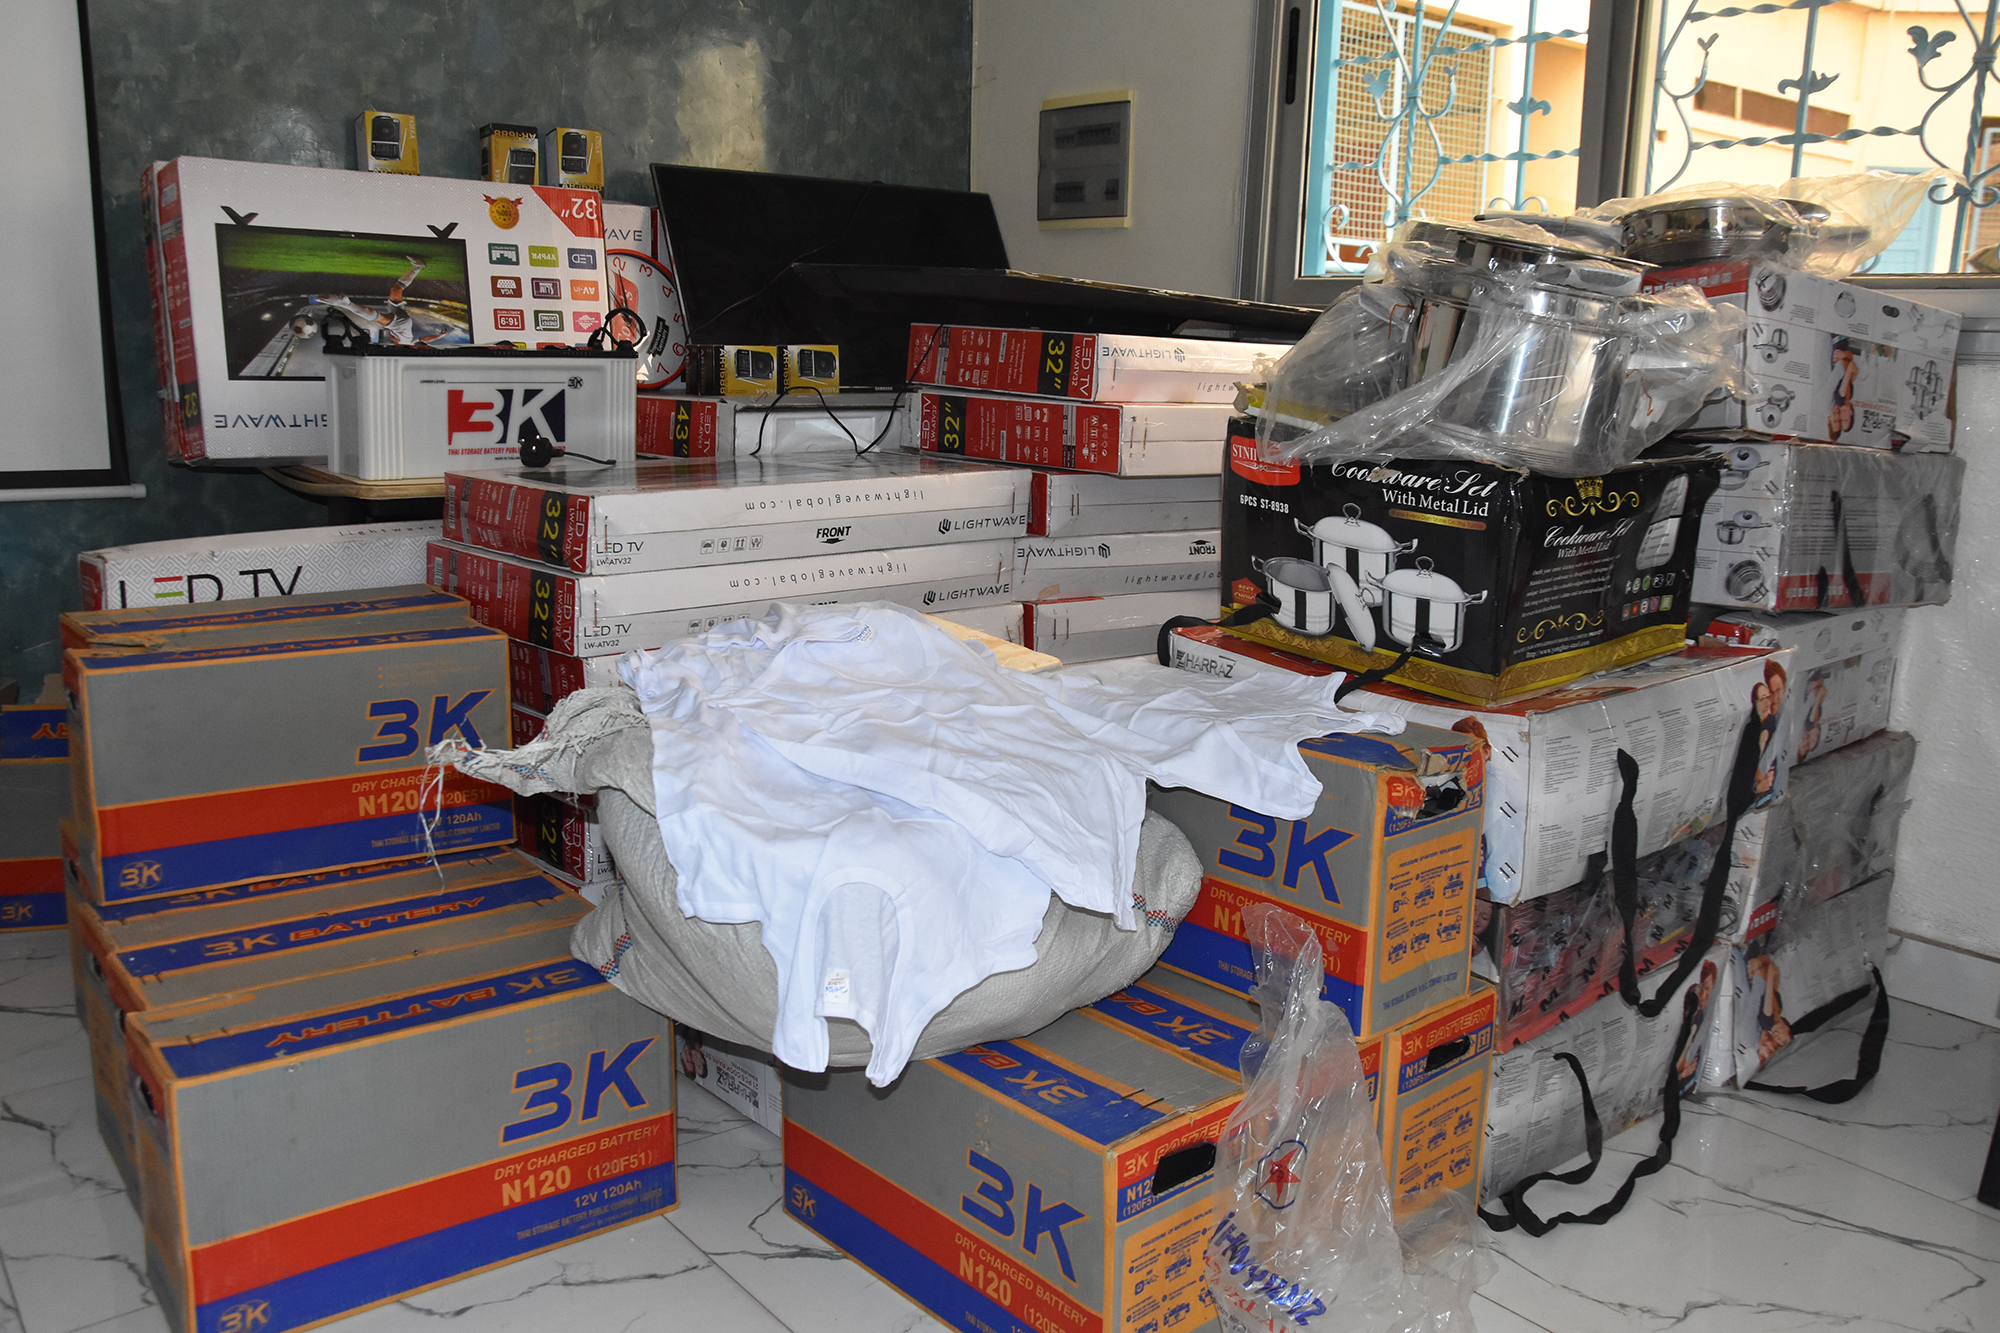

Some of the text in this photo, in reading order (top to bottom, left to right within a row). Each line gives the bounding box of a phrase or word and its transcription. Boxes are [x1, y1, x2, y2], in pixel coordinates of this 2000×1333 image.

[604, 228, 643, 241] AVE
[571, 254, 593, 264] LED
[612, 256, 627, 271] 2
[639, 263, 653, 277] 3
[573, 286, 596, 295] AV-in
[662, 284, 674, 298] 4
[500, 317, 518, 326] 16:9
[672, 342, 685, 356] 6
[1102, 346, 1171, 359] LIGHTWAVE
[656, 362, 670, 375] 7
[719, 348, 728, 394] AR-1688
[1046, 340, 1065, 389] 32"
[1072, 345, 1081, 386] LW-ATV32
[1079, 337, 1092, 396] LED TV
[568, 377, 583, 388] 3K
[447, 389, 565, 445] 3K
[703, 405, 712, 454] LED TV
[922, 396, 932, 449] LED TV
[944, 402, 959, 449] 32"
[676, 405, 689, 455] 43"
[1331, 461, 1498, 498] Cooware Set
[745, 489, 925, 511] lightwaveglobal.com
[1240, 494, 1289, 514] 6PCS ST-8938
[1382, 488, 1489, 517] With Metal Lid
[543, 498, 561, 558] 32"
[573, 498, 587, 569] LED TV
[816, 525, 852, 539] FRONT
[954, 515, 1026, 530] LIGHTWAVE
[1607, 518, 1635, 539] Set
[596, 541, 644, 554] LED TV
[1017, 546, 1095, 558] LIGHTWAVE
[1189, 545, 1216, 556] FRONT
[1558, 540, 1611, 558] With Metal Lid
[596, 558, 632, 566] LW-ATV32
[239, 566, 303, 598] TV
[729, 562, 908, 588] lightwaveglobal.com
[938, 583, 1010, 602] LIGHTWAVE
[534, 579, 550, 640] 32"
[561, 580, 573, 651] LED TV
[584, 623, 631, 638] LED TV
[584, 639, 619, 649] LW-ATV32
[355, 688, 497, 765] 3K
[351, 781, 377, 793] DRY
[1391, 783, 1415, 798] 3K
[359, 789, 420, 816] N120
[447, 812, 482, 825] 120Ah
[572, 853, 582, 875] TV
[1216, 803, 1361, 909] 3K
[120, 864, 162, 887] 3K
[1210, 886, 1234, 902] DRY
[2, 904, 33, 919] 3K
[204, 897, 485, 956] 3K BATTERY
[1305, 920, 1352, 945] ATTERY
[1218, 959, 1253, 981] THAI STORAGE
[265, 987, 497, 1048] BATTERY
[515, 968, 580, 995] 3K
[1154, 1015, 1234, 1045] 3K
[1403, 1004, 1490, 1056] 3K BATTERY
[499, 1035, 660, 1147] 3K
[1004, 1069, 1089, 1104] 3K
[494, 1123, 661, 1181] DRY CHARGED BATTERY
[502, 1150, 653, 1206] N120 (120F51)
[1123, 1155, 1149, 1178] 3K
[574, 1180, 642, 1208] 12V 120Ah
[791, 1188, 817, 1217] 3K
[1127, 1178, 1153, 1203] N12
[516, 1229, 531, 1240] THAI
[532, 1222, 561, 1236] STORAGE
[561, 1213, 588, 1229] BATTERY
[588, 1205, 610, 1220] PUBLIC
[960, 1147, 1091, 1288] 3K
[955, 1232, 1087, 1328] DRY CHARGED BATTERY
[959, 1251, 1012, 1307] N120
[219, 1301, 270, 1333] 3K
